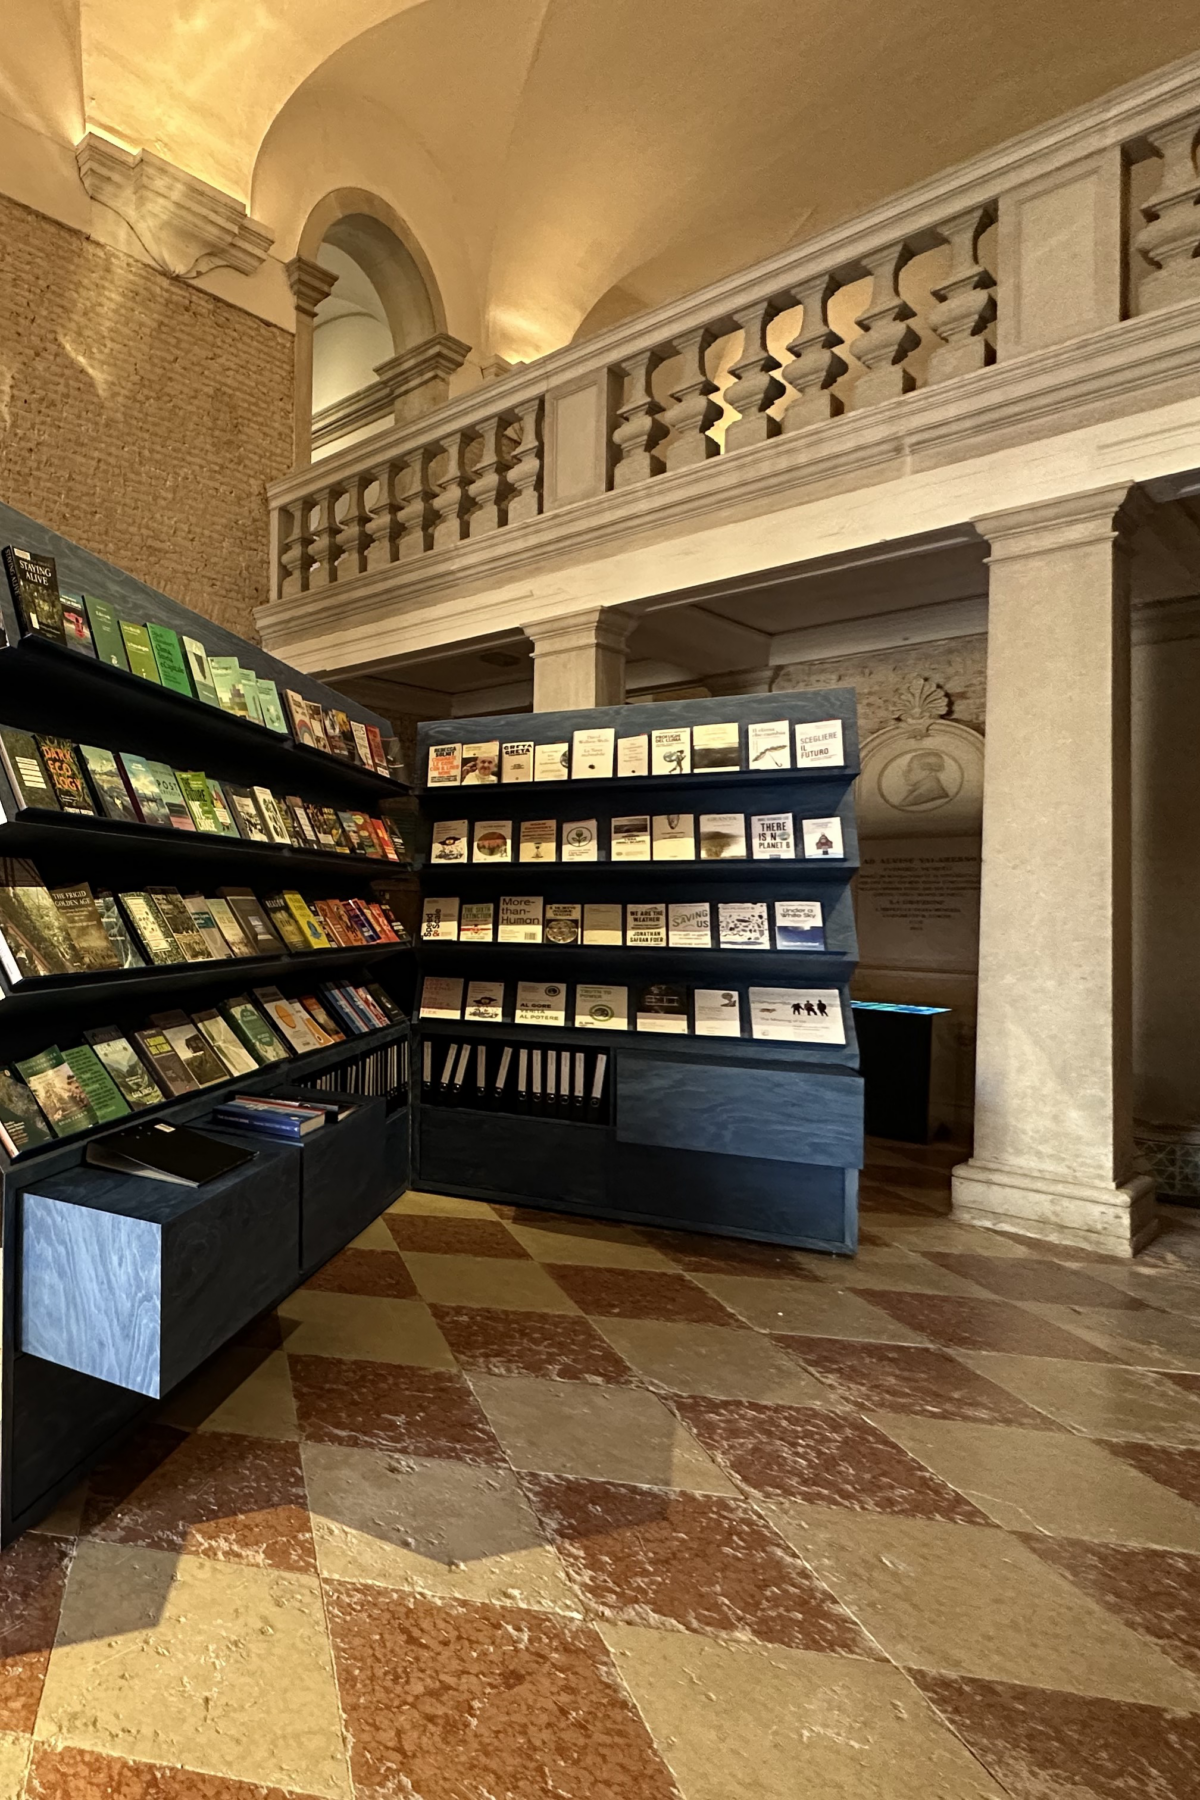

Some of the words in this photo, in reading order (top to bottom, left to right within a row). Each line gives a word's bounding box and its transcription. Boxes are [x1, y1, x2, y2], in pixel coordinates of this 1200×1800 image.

[5, 549, 14, 576] STAYING
[10, 576, 20, 596] ALIVE
[20, 560, 52, 578] STAYING
[25, 571, 48, 586] ALIVE
[800, 732, 838, 745] SCEGLIERE
[43, 746, 74, 762] DARK
[800, 748, 829, 759] FUTURO
[48, 760, 71, 775] ECO
[53, 775, 82, 792] LOGY
[156, 779, 178, 791] POST
[761, 822, 787, 832] THERE
[758, 833, 767, 842] IS
[758, 841, 783, 849] PLANET
[785, 841, 791, 849] B
[65, 890, 87, 899] FRIGID
[54, 899, 78, 907] GOLDEN
[79, 898, 91, 906] AGE
[502, 897, 535, 906] More-
[464, 905, 474, 913] THE
[475, 905, 491, 913] SIXTH
[501, 906, 530, 915] than-
[432, 908, 442, 929] Scale
[501, 916, 539, 925] Human
[672, 908, 708, 928] SAVING
[696, 919, 709, 928] US
[423, 912, 433, 937] Speed
[432, 929, 440, 937] &
[58, 1117, 70, 1126] BRIAN
[71, 1111, 88, 1122] FAGAN
